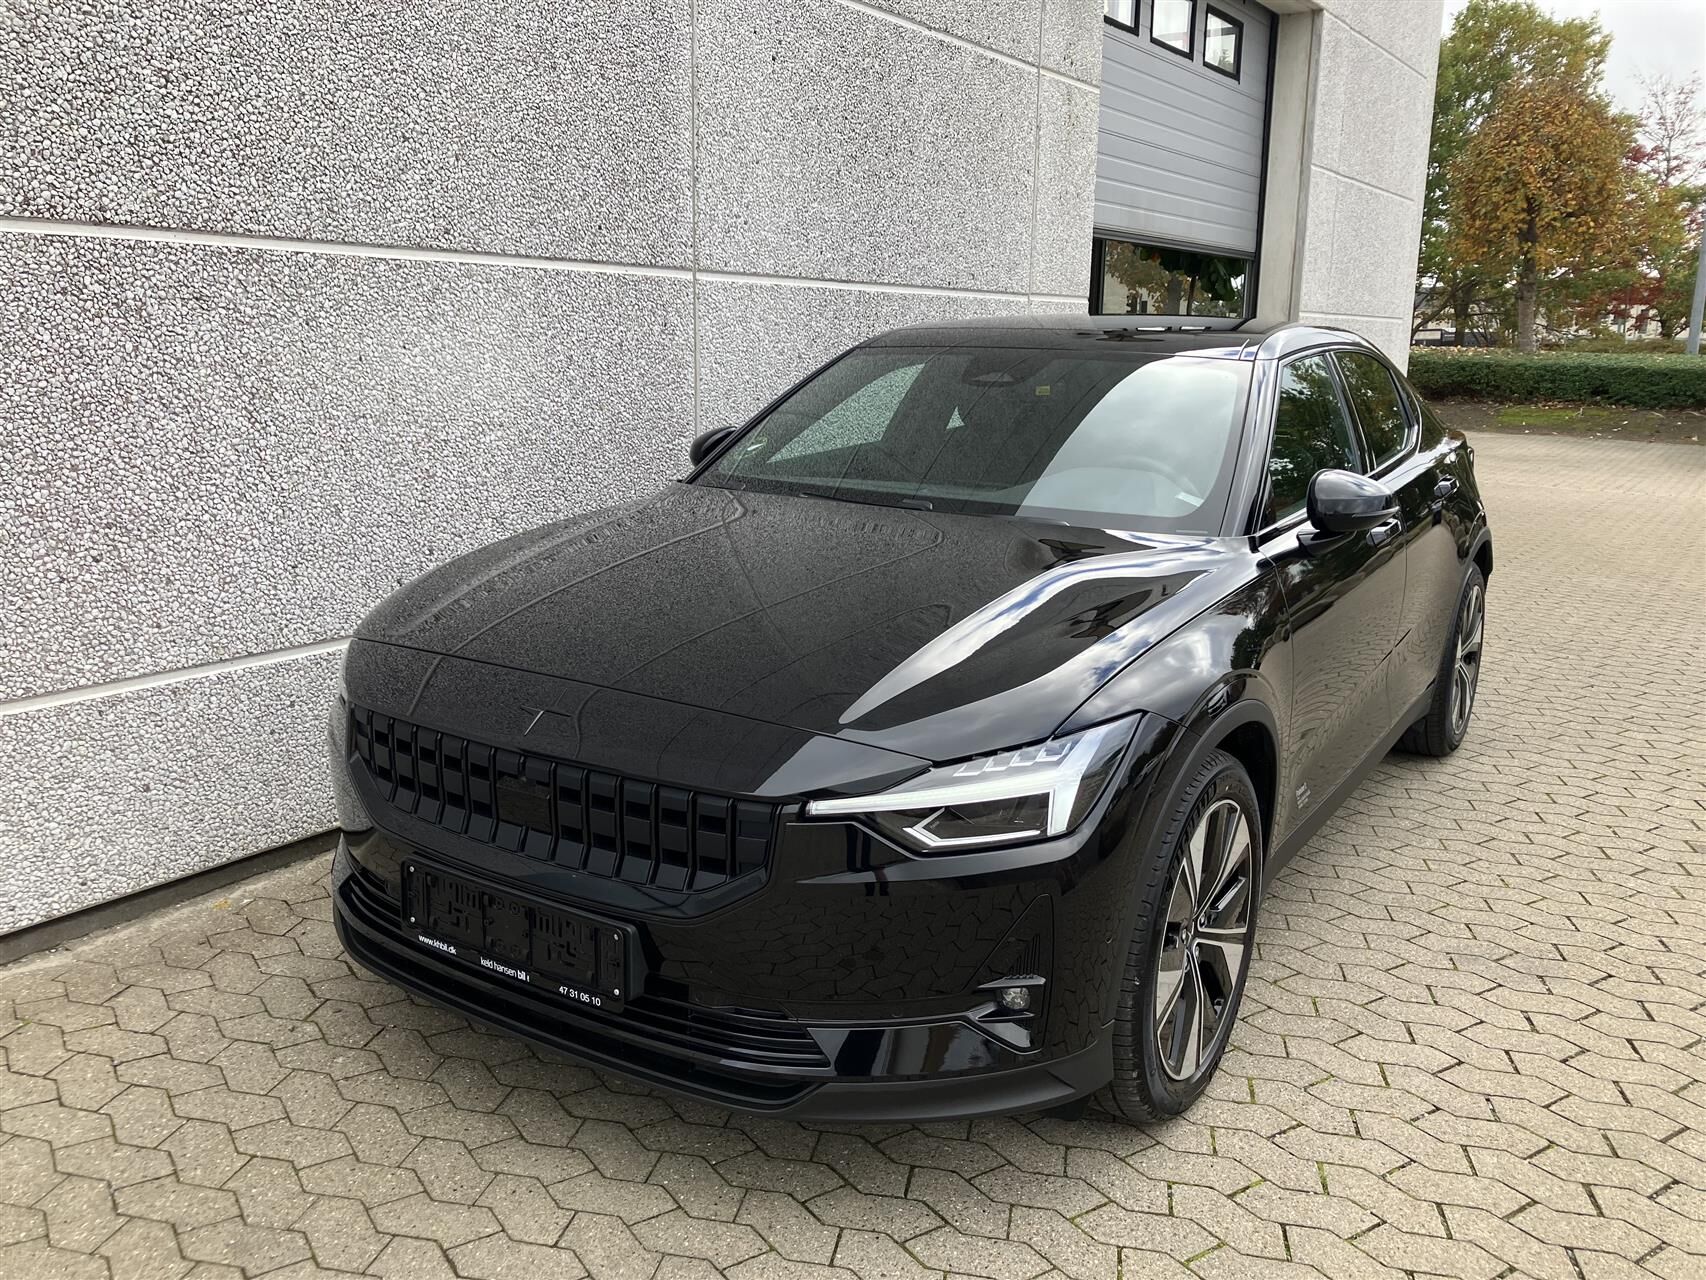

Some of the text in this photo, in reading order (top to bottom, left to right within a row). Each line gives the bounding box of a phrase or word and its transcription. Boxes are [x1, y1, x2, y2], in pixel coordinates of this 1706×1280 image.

[480, 956, 494, 969] keld
[494, 961, 517, 978] hansen
[559, 985, 602, 1007] 47 31 05 10
